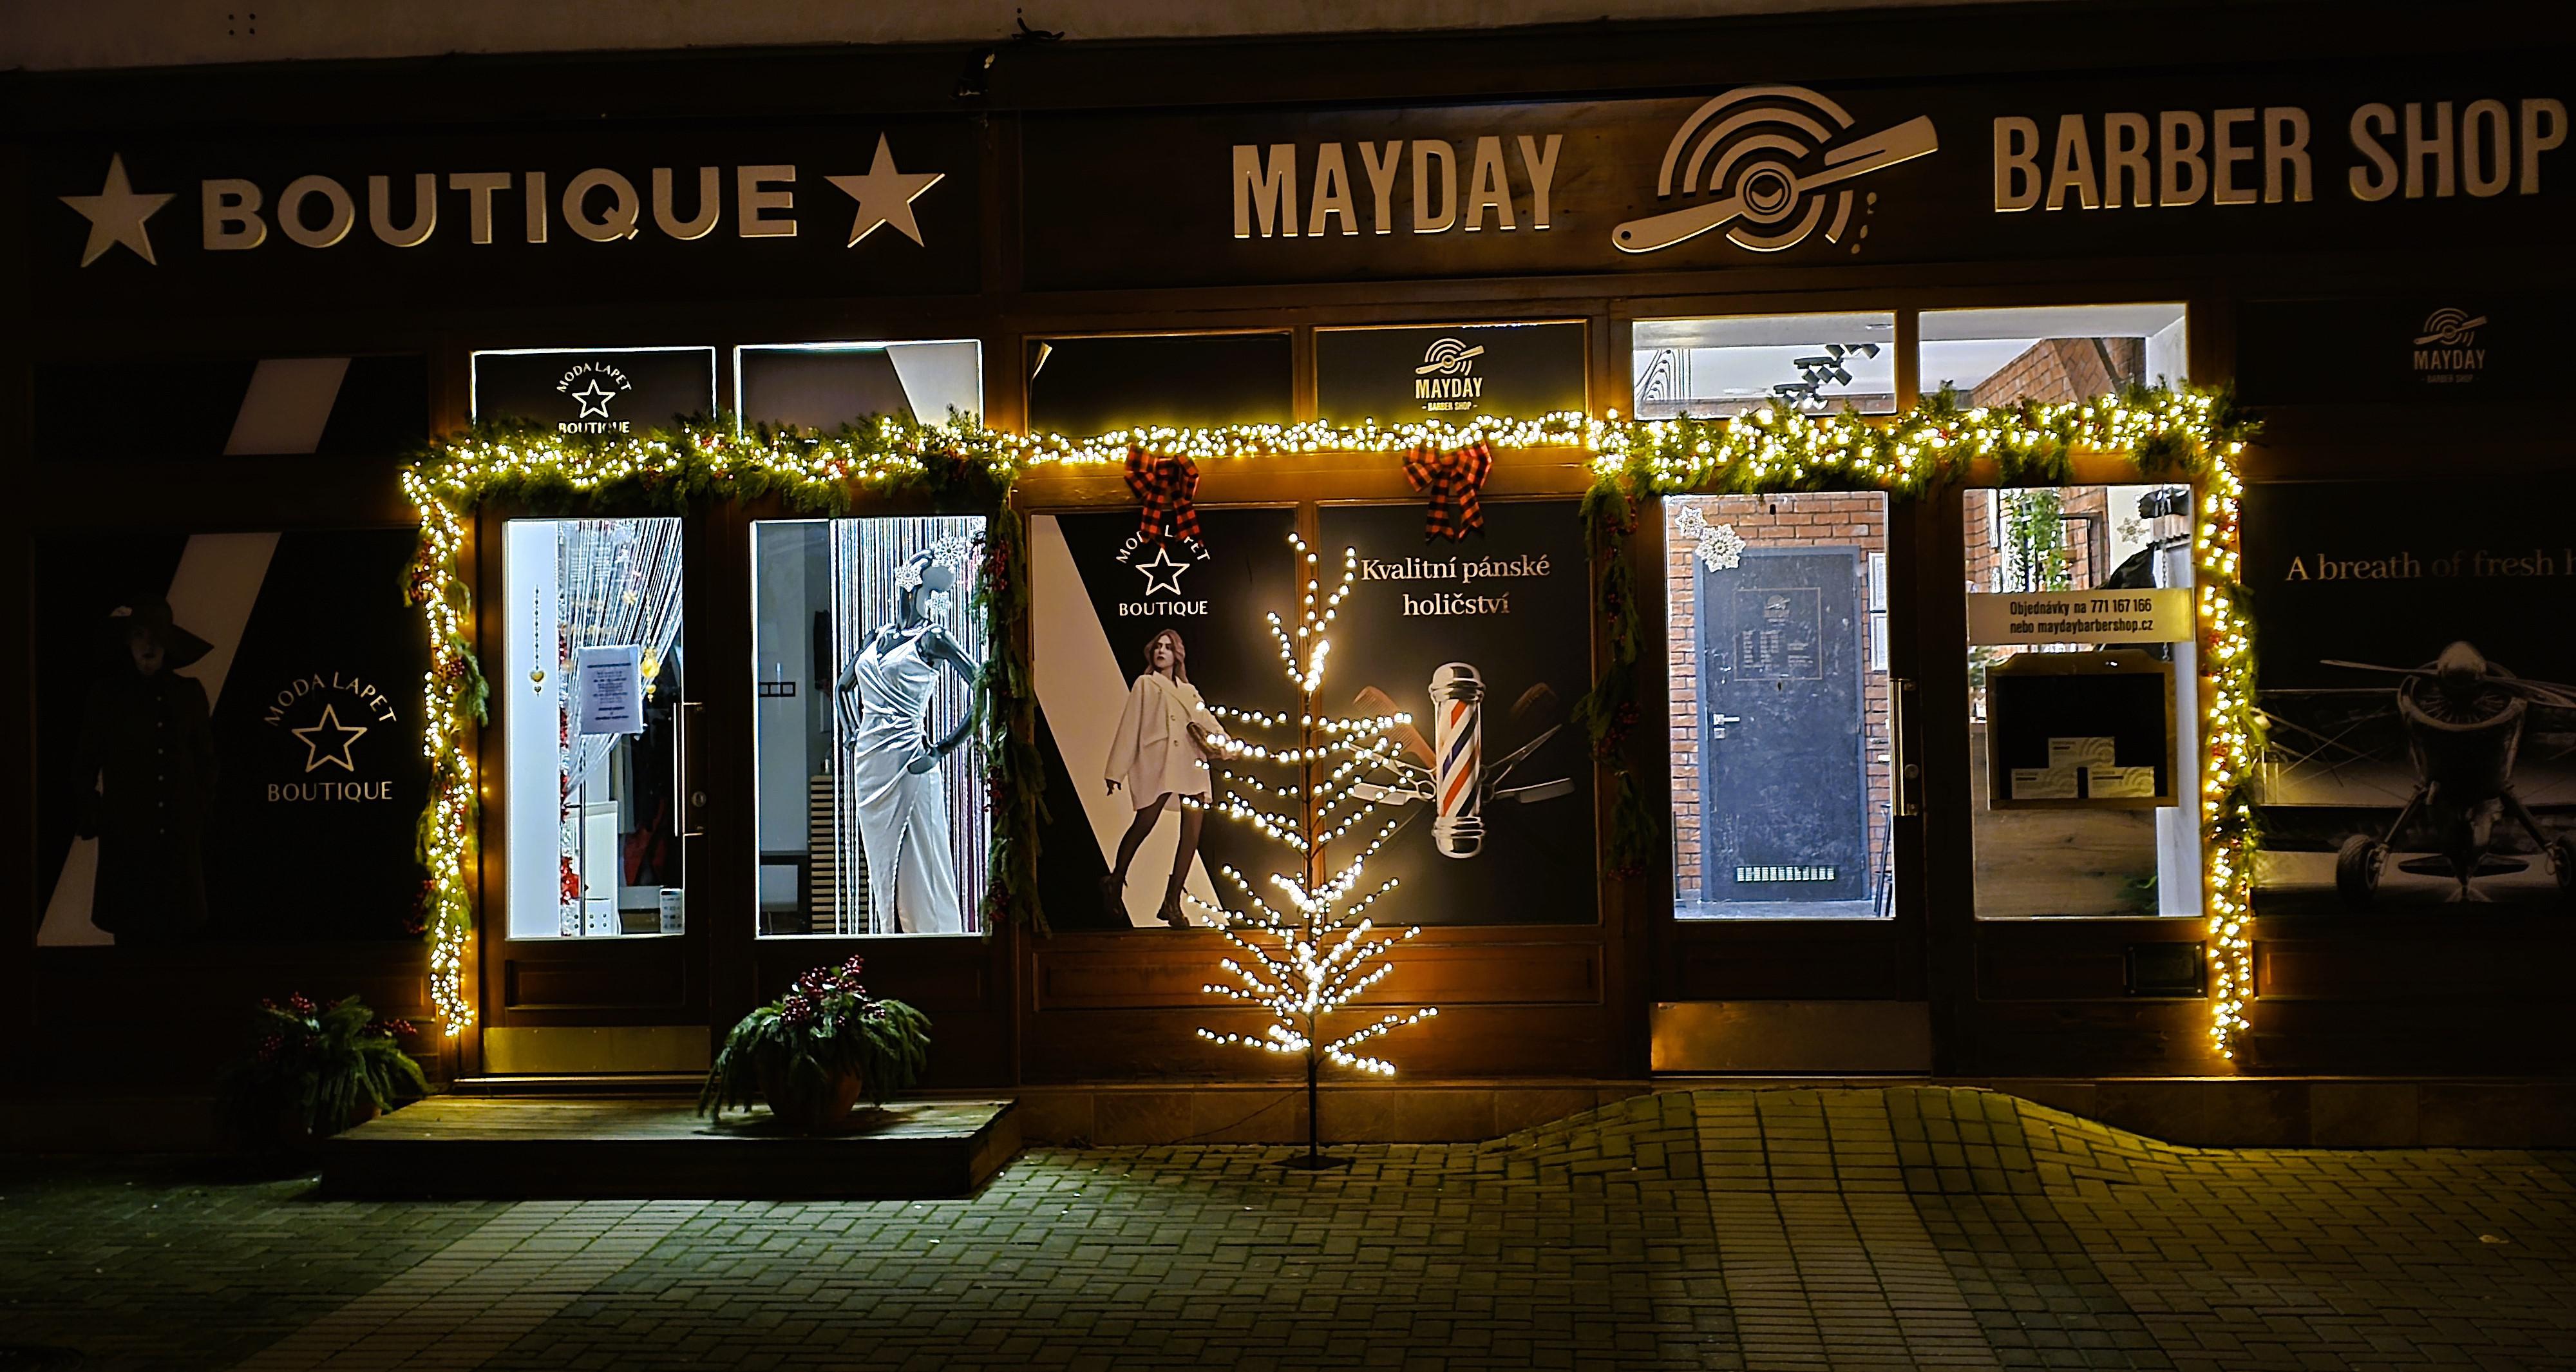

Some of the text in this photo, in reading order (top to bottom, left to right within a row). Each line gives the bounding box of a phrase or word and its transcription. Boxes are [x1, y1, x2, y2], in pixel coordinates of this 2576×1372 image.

[1993, 97, 2569, 213] BARBER SHOP
[1232, 134, 1564, 238] MAYDAY
[202, 164, 798, 251] BOUTIQUE
[2412, 348, 2486, 370] MAYDAY
[556, 361, 632, 393] MODA LAPET
[1415, 377, 1483, 399] MAYDAY
[1361, 554, 1551, 584] Kvalitní pánské
[2286, 556, 2311, 580] A
[2317, 551, 2423, 581] breath
[2431, 549, 2466, 578] of
[2473, 548, 2555, 577] fresh
[1119, 600, 1209, 617] BOUTIQUE
[1402, 591, 1511, 616] holičství
[2009, 598, 2152, 616] Objednávky na 771 167 166
[2010, 618, 2154, 635] nebo maydaybarbershop.cz
[263, 671, 398, 727] MODA LAPET
[267, 781, 393, 803] BOUTIQUE
